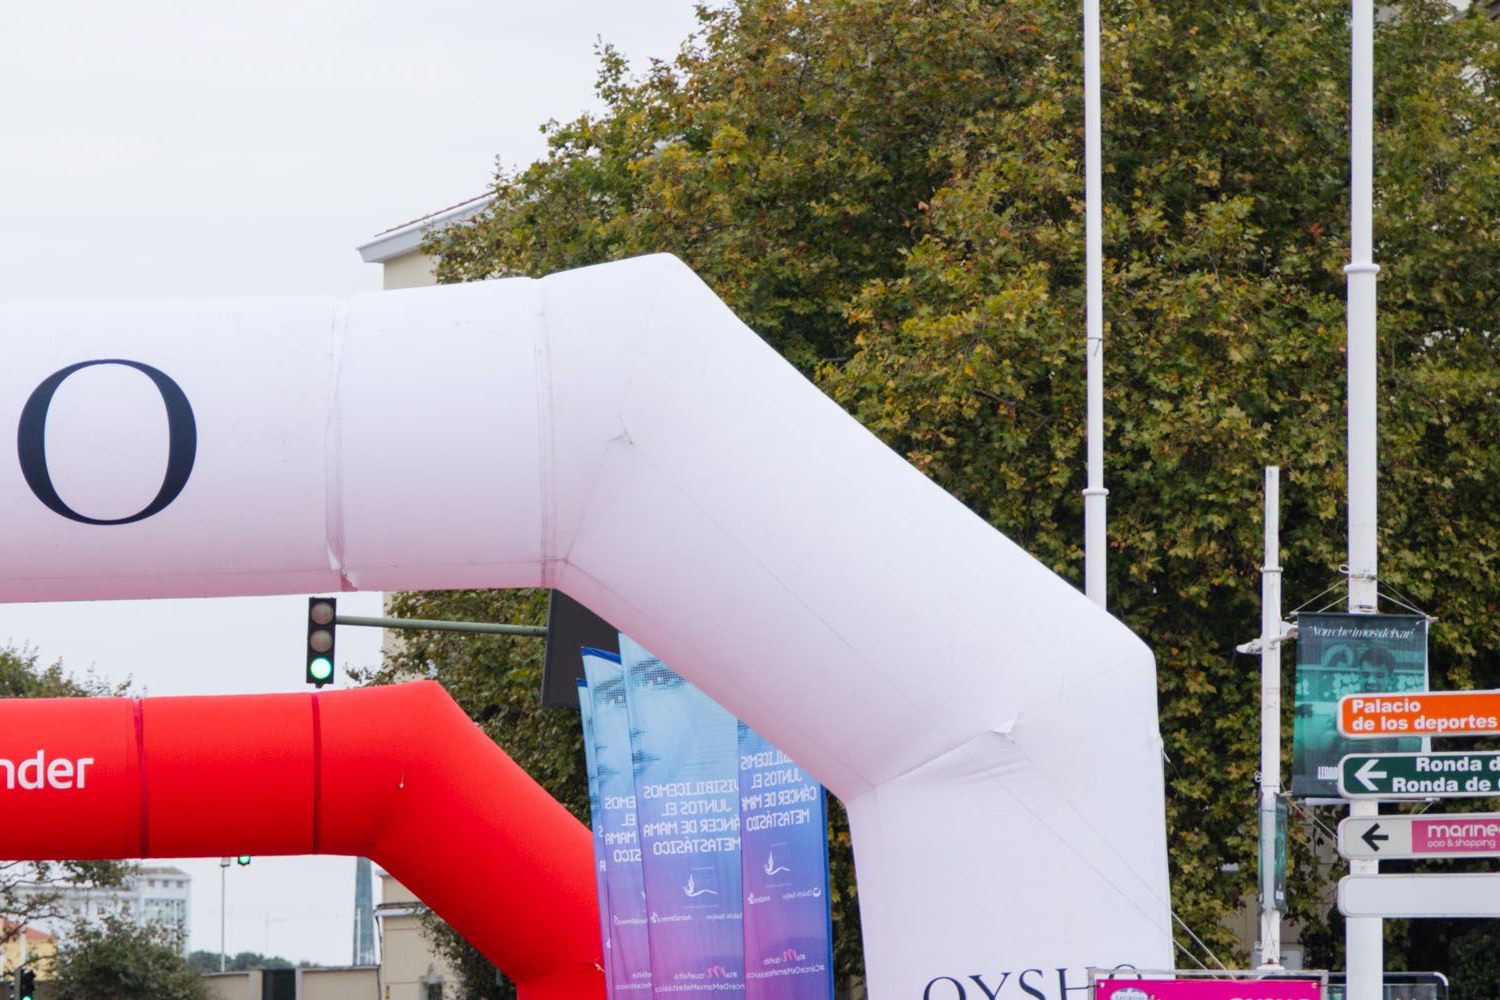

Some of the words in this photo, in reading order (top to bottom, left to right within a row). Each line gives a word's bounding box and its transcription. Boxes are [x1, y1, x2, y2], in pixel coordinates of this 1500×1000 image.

[1352, 698, 1421, 713] Palacio
[1352, 716, 1375, 731] de
[1381, 716, 1408, 730] los
[1414, 715, 1498, 732] deportes
[1416, 756, 1482, 772] Ronda
[1392, 777, 1459, 792] Ronda
[1465, 777, 1491, 791] de
[1427, 823, 1500, 838] marine
[1427, 839, 1445, 847] ocio
[1455, 838, 1496, 849] shopping
